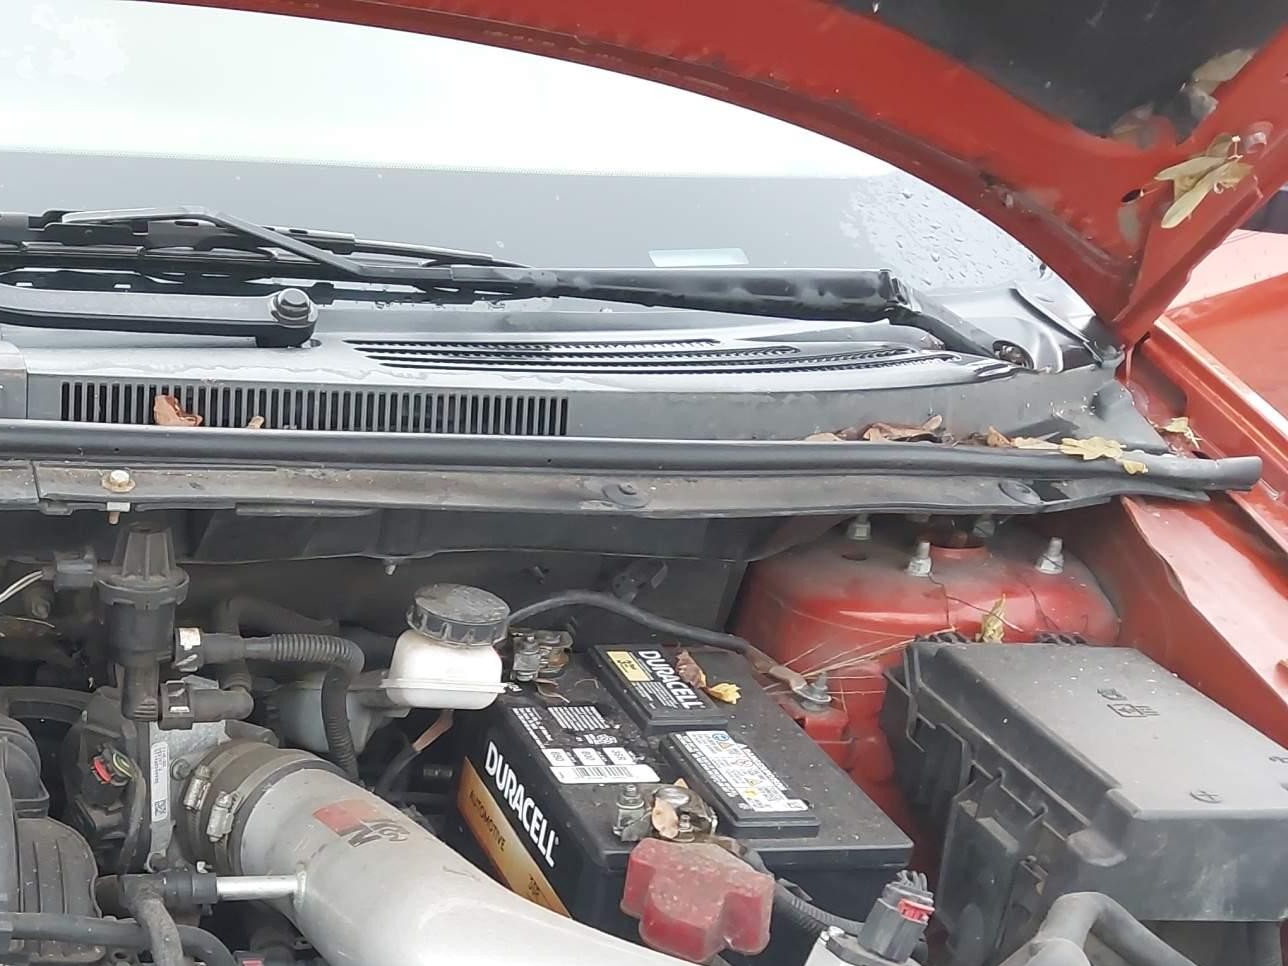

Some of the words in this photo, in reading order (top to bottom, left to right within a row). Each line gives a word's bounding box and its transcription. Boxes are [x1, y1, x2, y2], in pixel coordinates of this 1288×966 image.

[637, 650, 702, 710] DURACELL
[469, 790, 506, 852] AUTOMOTIVE
[484, 740, 557, 868] DURACELL
